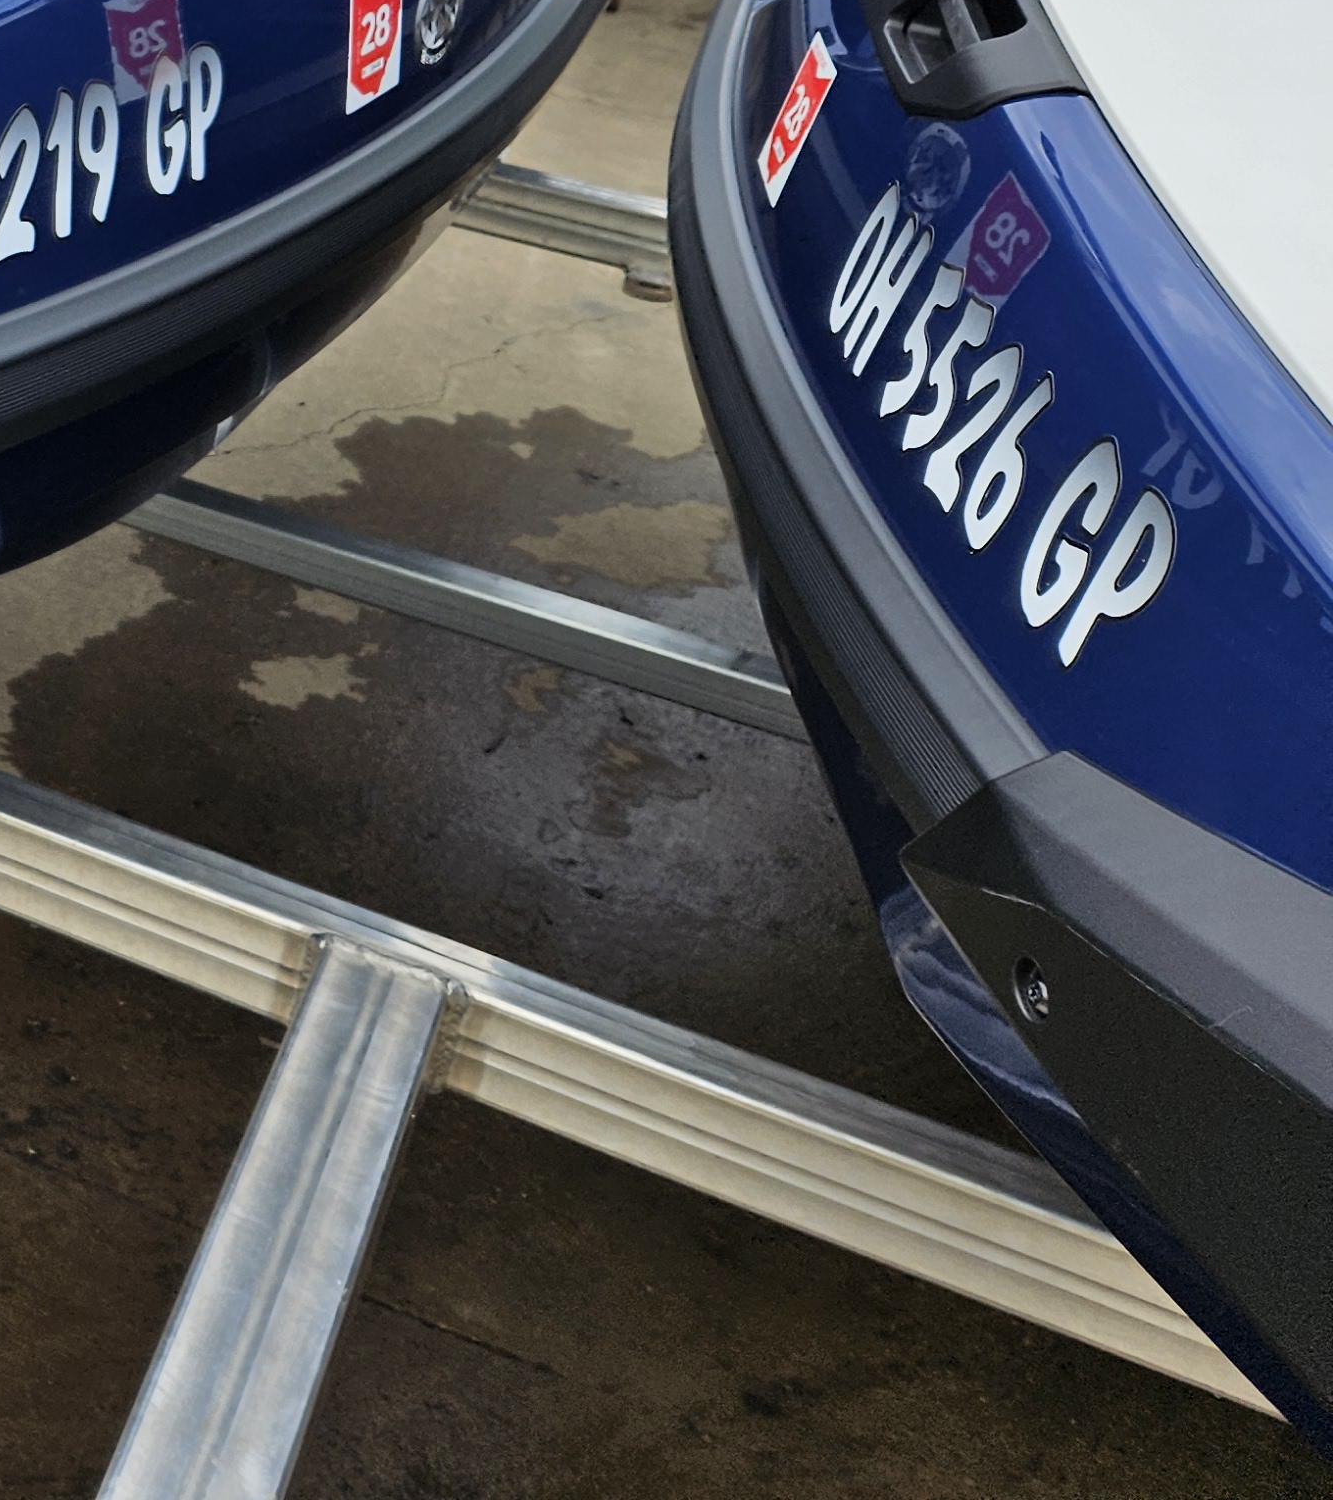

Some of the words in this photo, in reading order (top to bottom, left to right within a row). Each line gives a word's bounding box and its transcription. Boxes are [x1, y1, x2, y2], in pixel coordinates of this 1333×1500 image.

[360, 3, 391, 57] 28
[783, 83, 812, 142] 28
[145, 42, 223, 195] GP
[829, 180, 935, 378] OH
[879, 261, 1055, 555] 5526
[1020, 434, 1177, 669] GP
